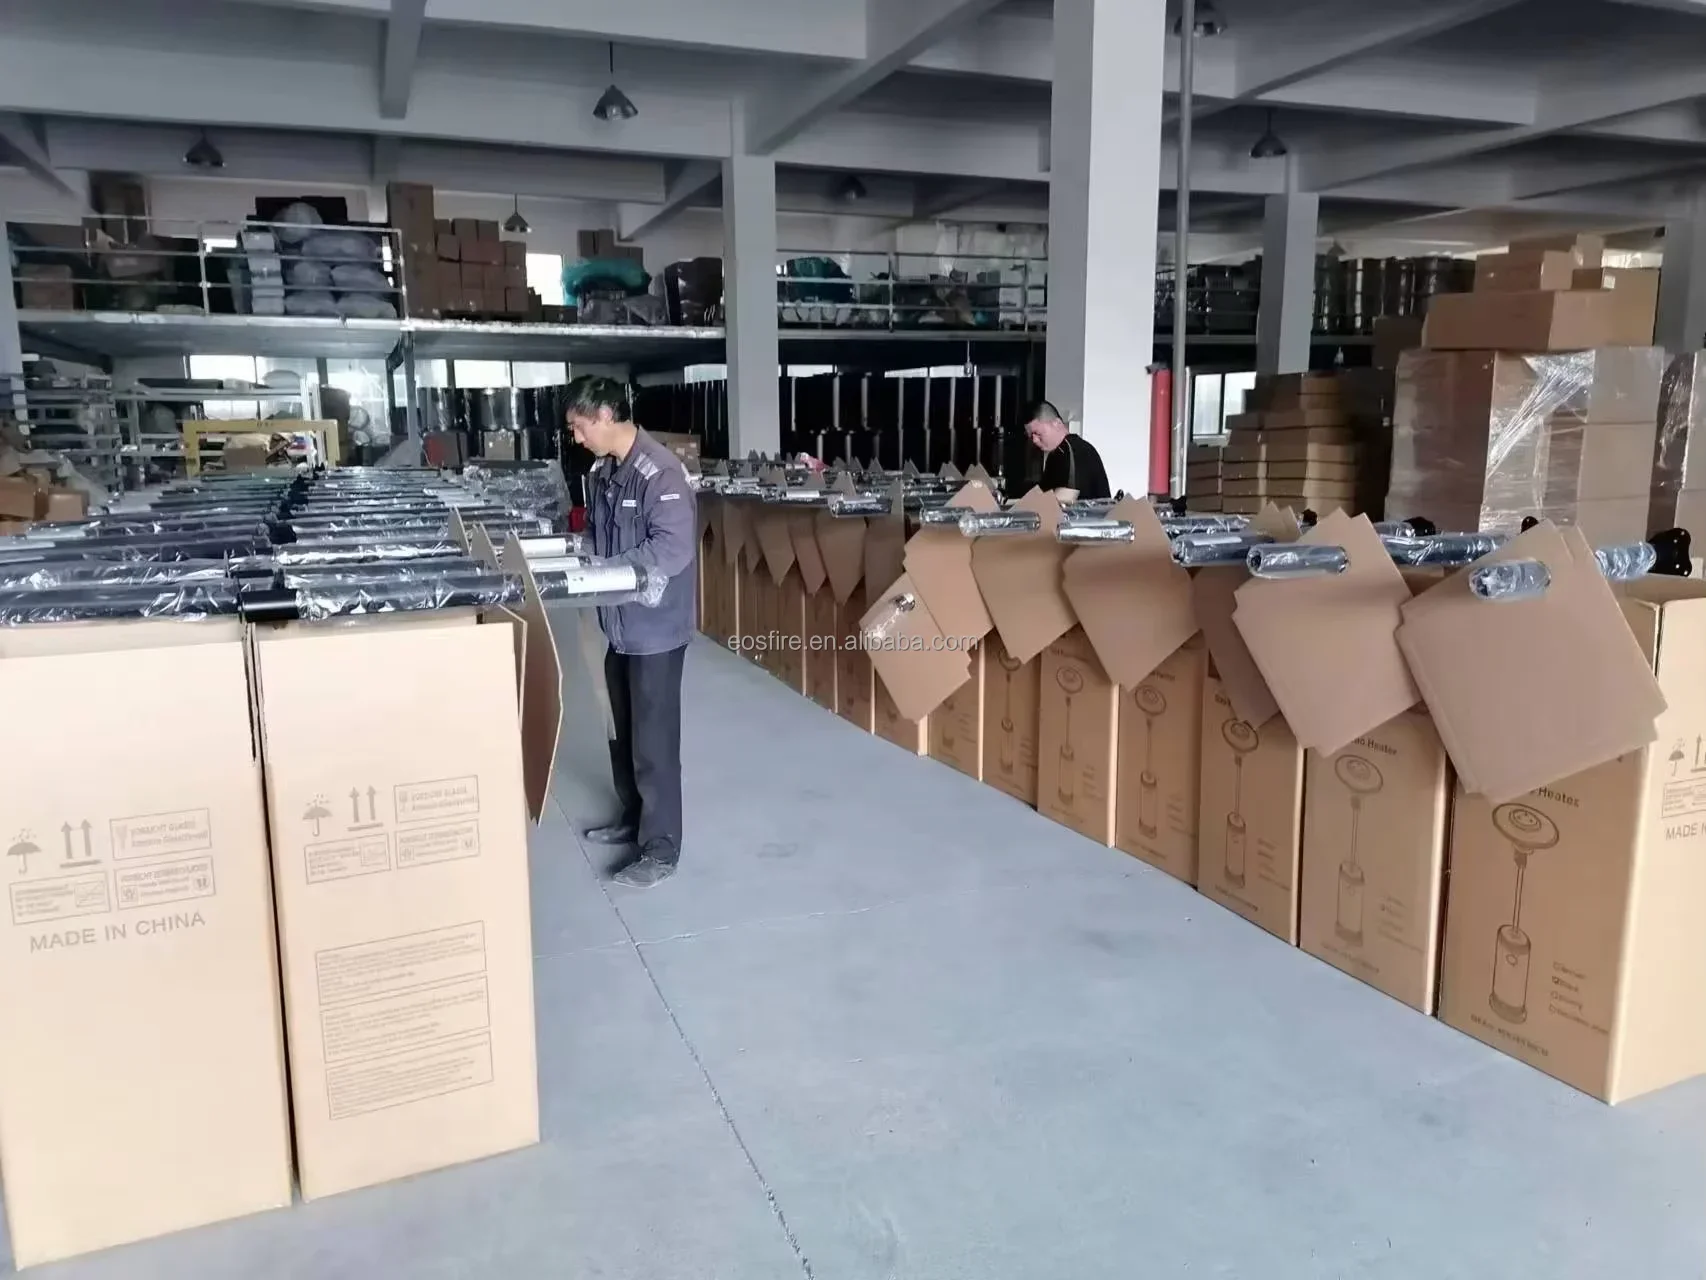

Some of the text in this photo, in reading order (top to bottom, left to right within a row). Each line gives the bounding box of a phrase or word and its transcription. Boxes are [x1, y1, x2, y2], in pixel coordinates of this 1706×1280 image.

[1665, 823, 1698, 841] MADE
[29, 911, 207, 954] MADE IN CHINA
